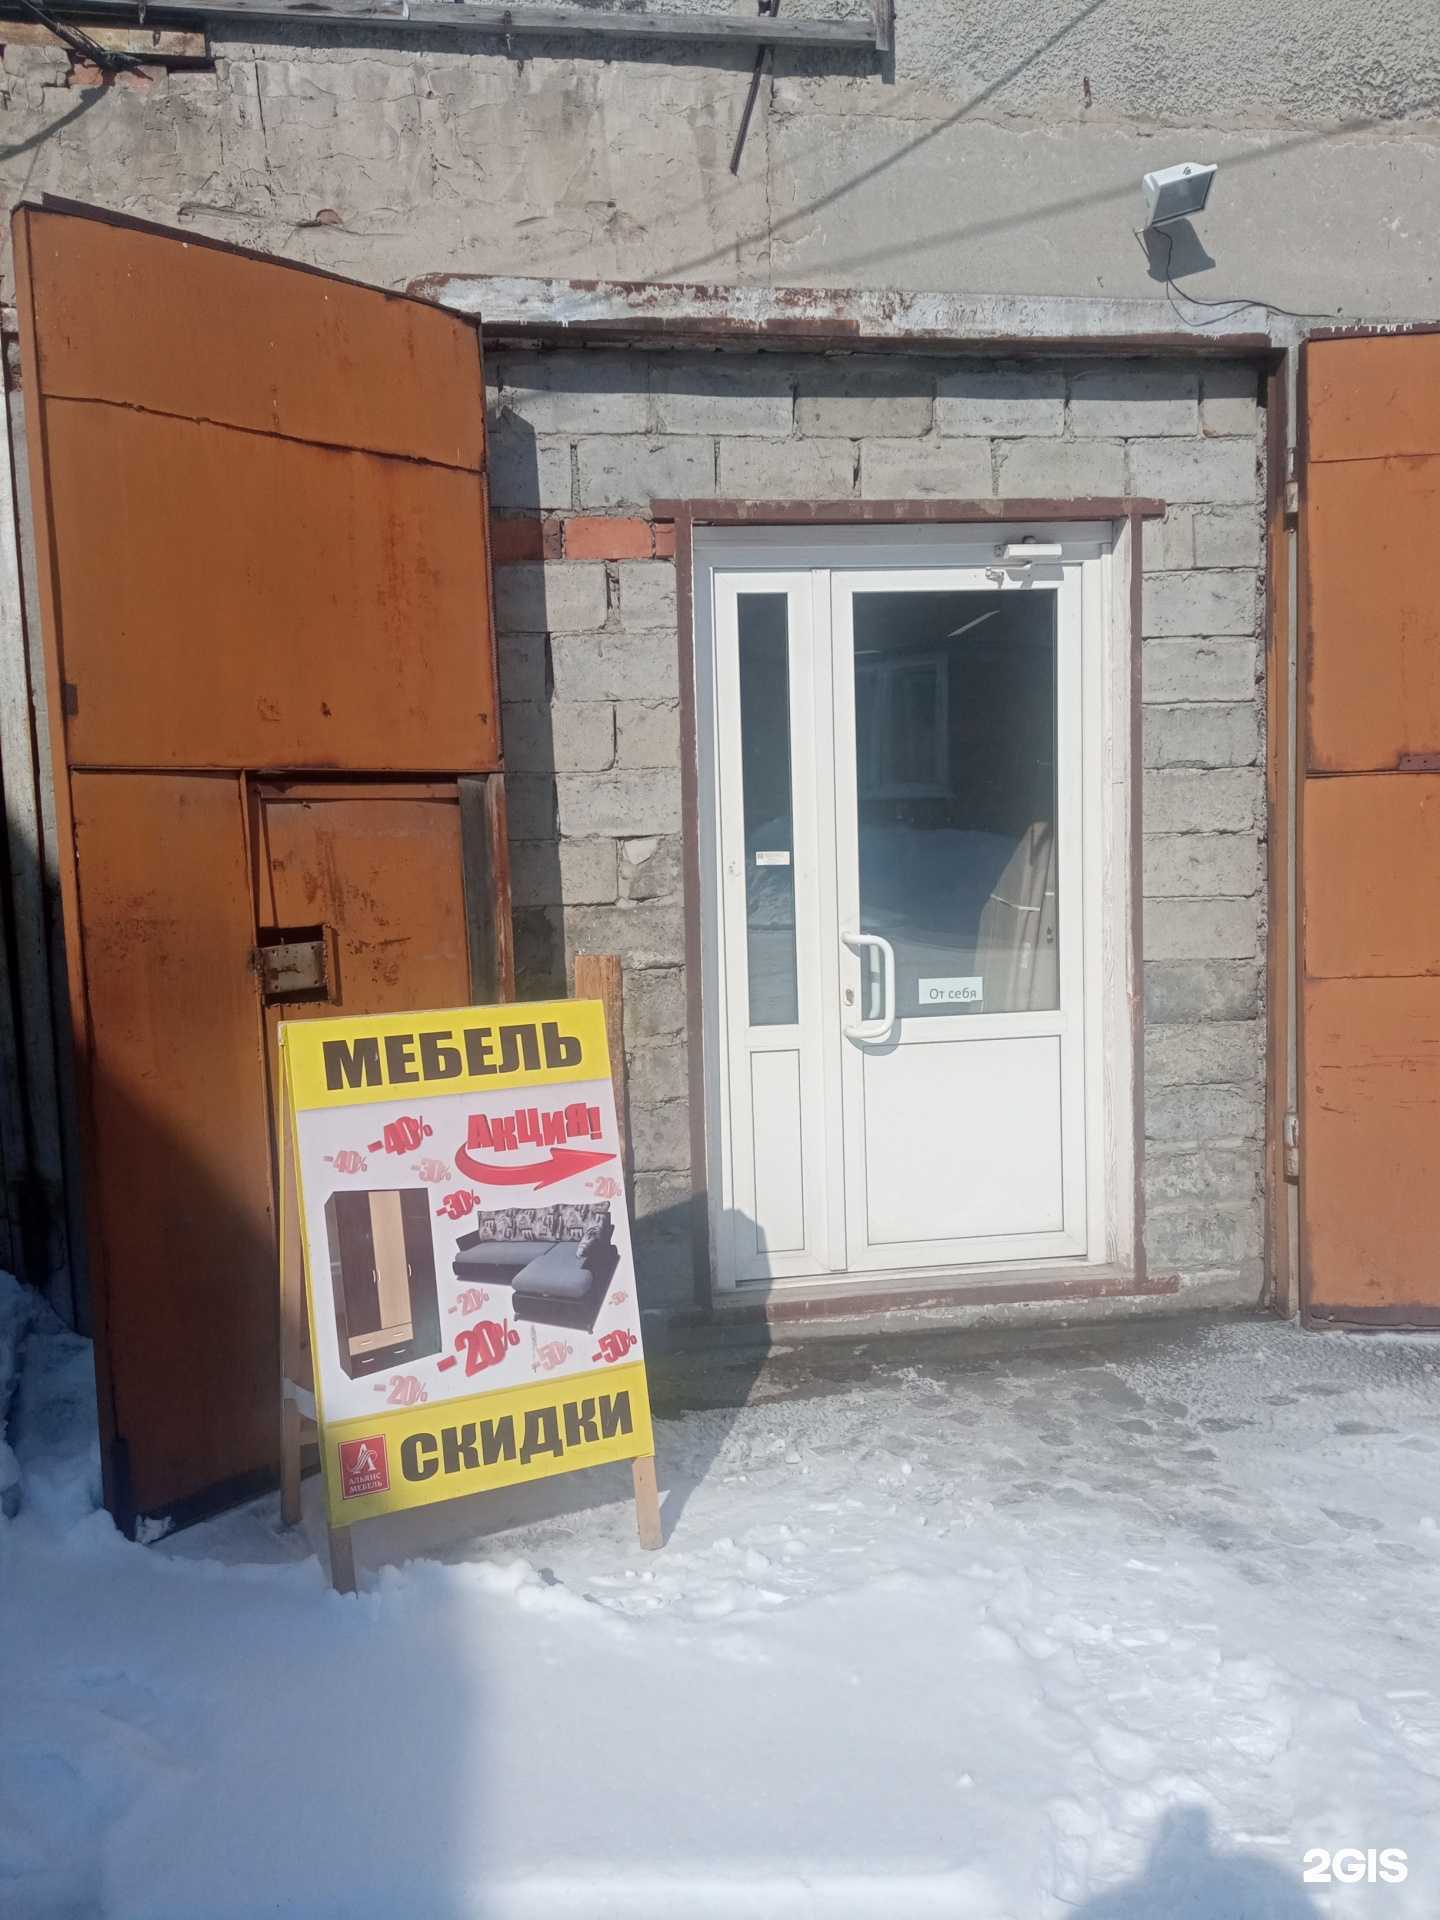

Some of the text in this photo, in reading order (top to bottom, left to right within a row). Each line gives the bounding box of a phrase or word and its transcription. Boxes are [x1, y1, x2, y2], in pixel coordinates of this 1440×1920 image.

[930, 987, 977, 1000] От себя
[322, 1021, 583, 1091] МЕБЕЛЬ
[368, 1115, 434, 1155] -40%
[467, 1102, 603, 1153] АКЦИЯ!
[323, 1150, 368, 1174] -40%
[436, 1188, 481, 1220] -30%
[437, 1318, 521, 1377] -20%
[593, 1328, 638, 1363] -50%
[374, 1375, 428, 1406] -20%
[400, 1390, 634, 1482] СКИДКИ
